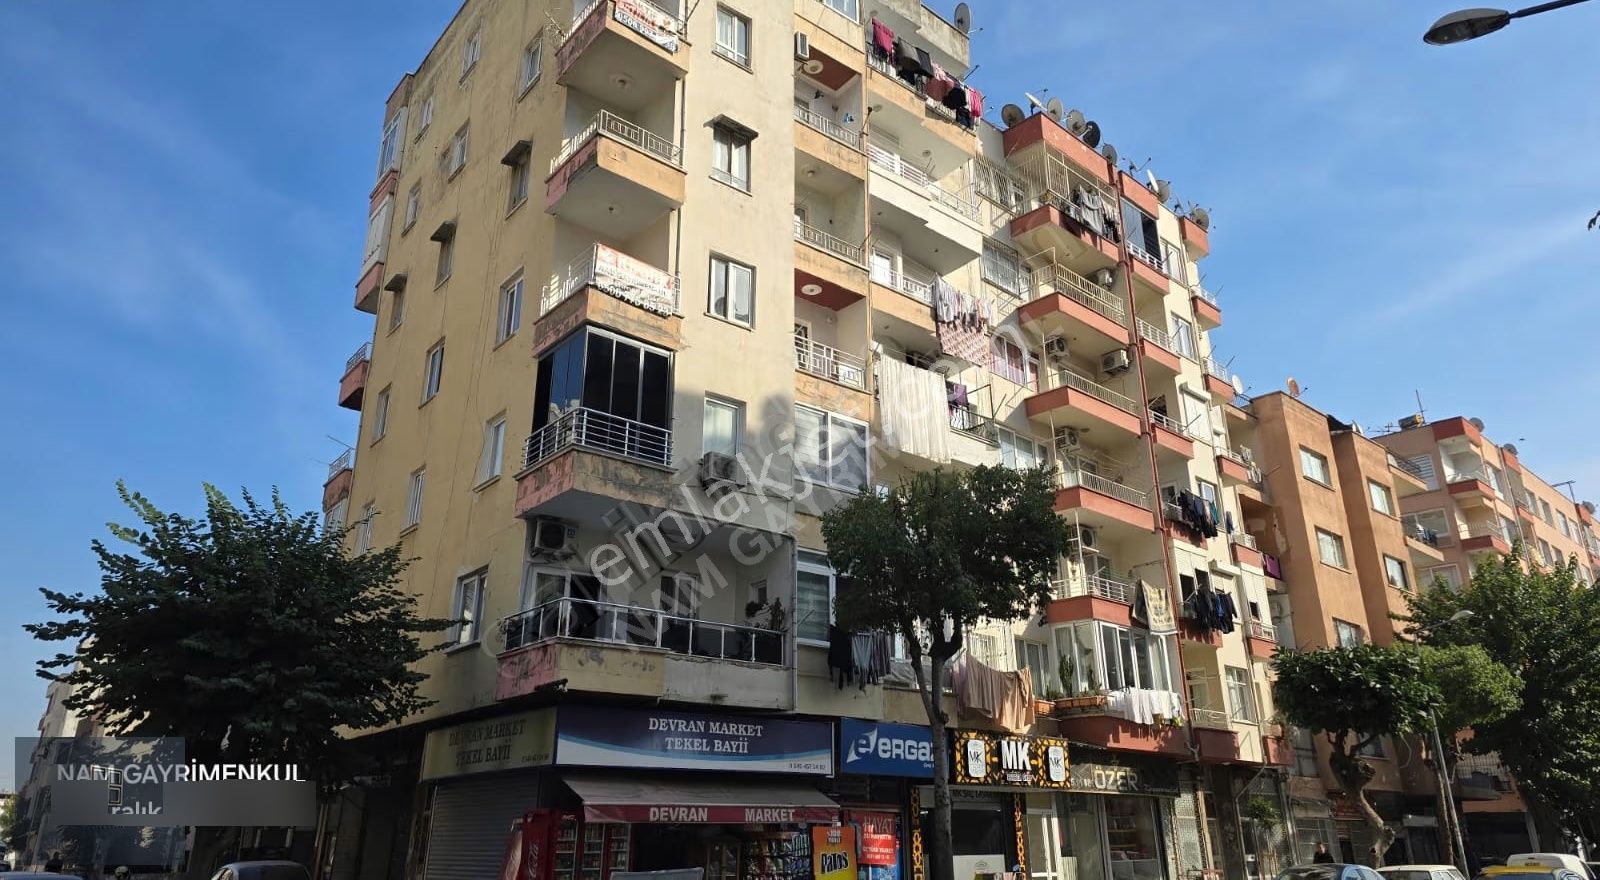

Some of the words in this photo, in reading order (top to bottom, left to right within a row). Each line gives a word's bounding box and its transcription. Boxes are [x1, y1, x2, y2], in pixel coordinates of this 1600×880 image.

[485, 718, 528, 741] MARKET
[648, 717, 706, 734] DEVRAN
[709, 722, 764, 737] MARKET
[664, 736, 711, 752] TEKEL
[1001, 739, 1032, 770] MK
[1093, 764, 1139, 791] ÖZER
[649, 806, 708, 822] DEVRAN
[745, 807, 796, 822] MARKET
[863, 815, 893, 835] HAYAT
